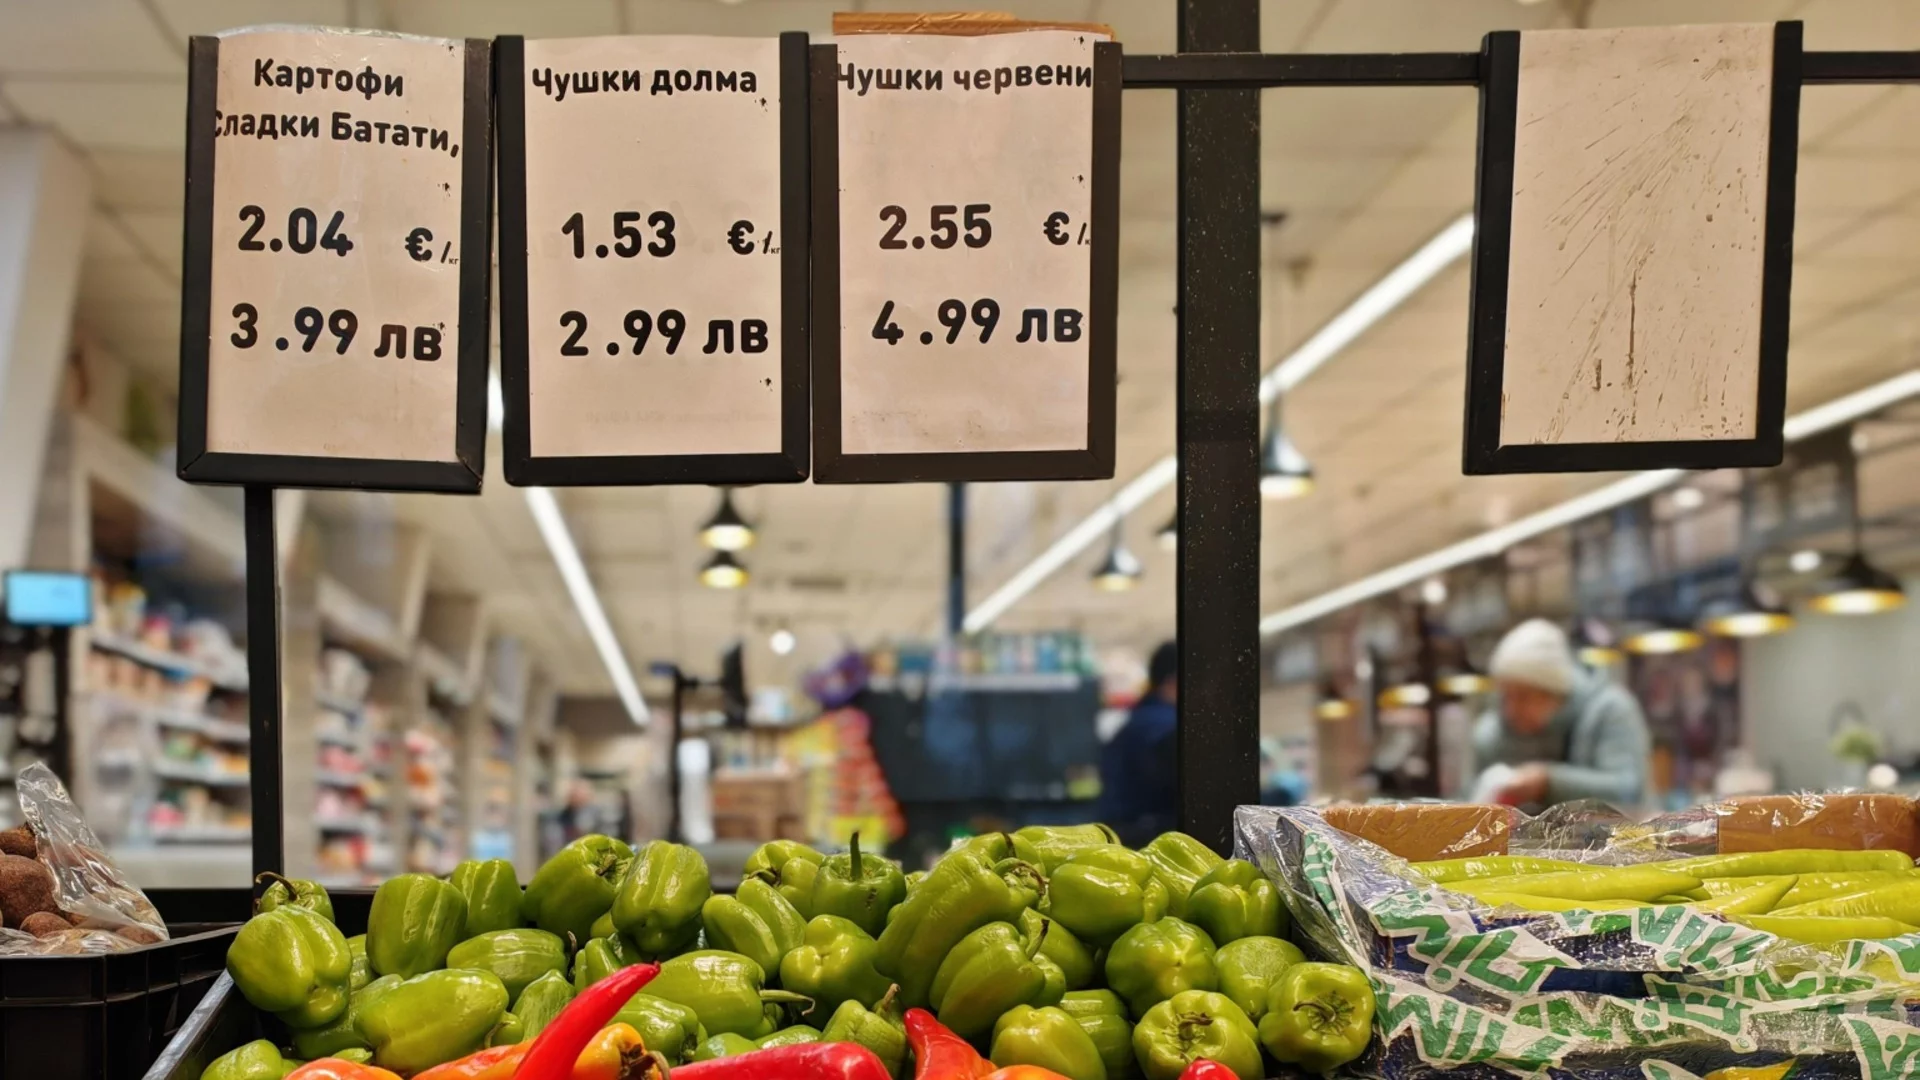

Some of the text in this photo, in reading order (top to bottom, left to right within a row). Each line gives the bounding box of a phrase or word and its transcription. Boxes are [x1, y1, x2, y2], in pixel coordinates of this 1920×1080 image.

[254, 58, 404, 99] Картофи
[532, 67, 757, 102] Чушки долма
[837, 62, 1092, 97] Чушки червени
[331, 111, 460, 158] Батати,
[237, 204, 354, 257] 2.04
[561, 210, 676, 259] 1.53
[879, 203, 992, 250] 2.55
[373, 323, 442, 362] лв
[702, 318, 769, 355] лв
[1015, 308, 1083, 344] лв
